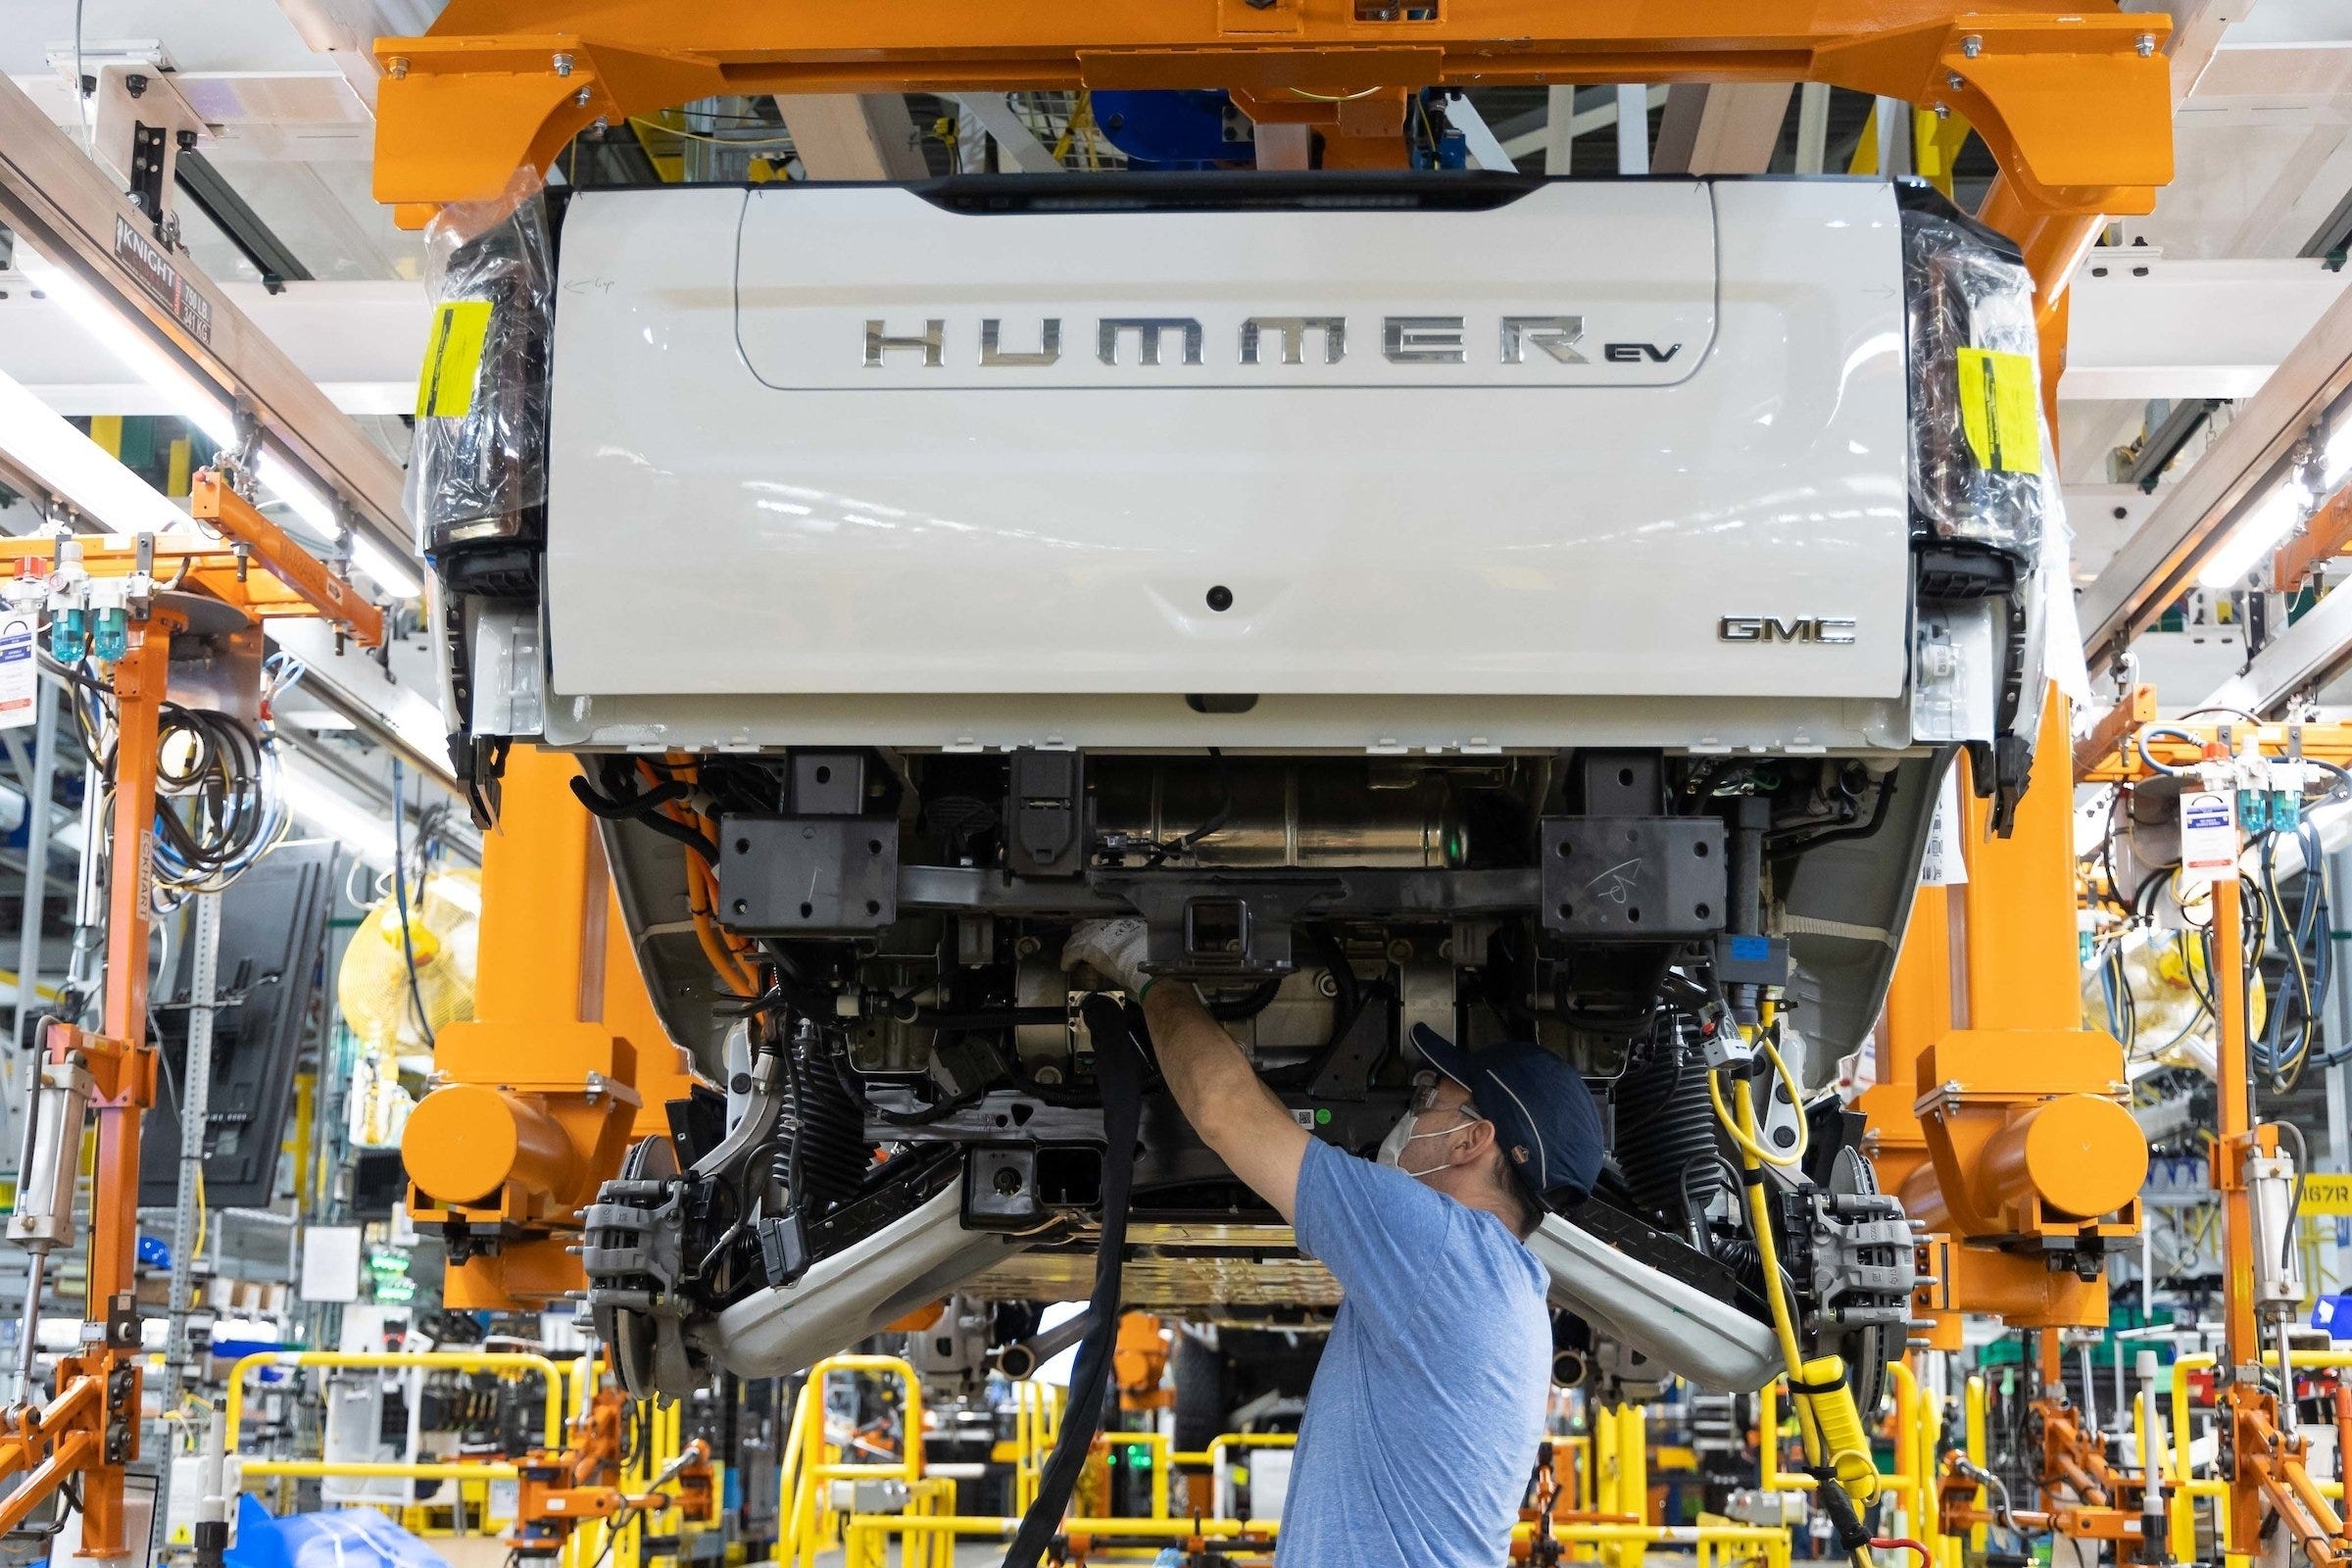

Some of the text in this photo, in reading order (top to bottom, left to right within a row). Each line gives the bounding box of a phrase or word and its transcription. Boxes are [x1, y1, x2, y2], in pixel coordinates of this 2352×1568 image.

[122, 220, 176, 288] KNIGHT
[862, 316, 1683, 368] HUMMER EV
[1718, 614, 1856, 644] GMC
[139, 831, 152, 916] ECKHART
